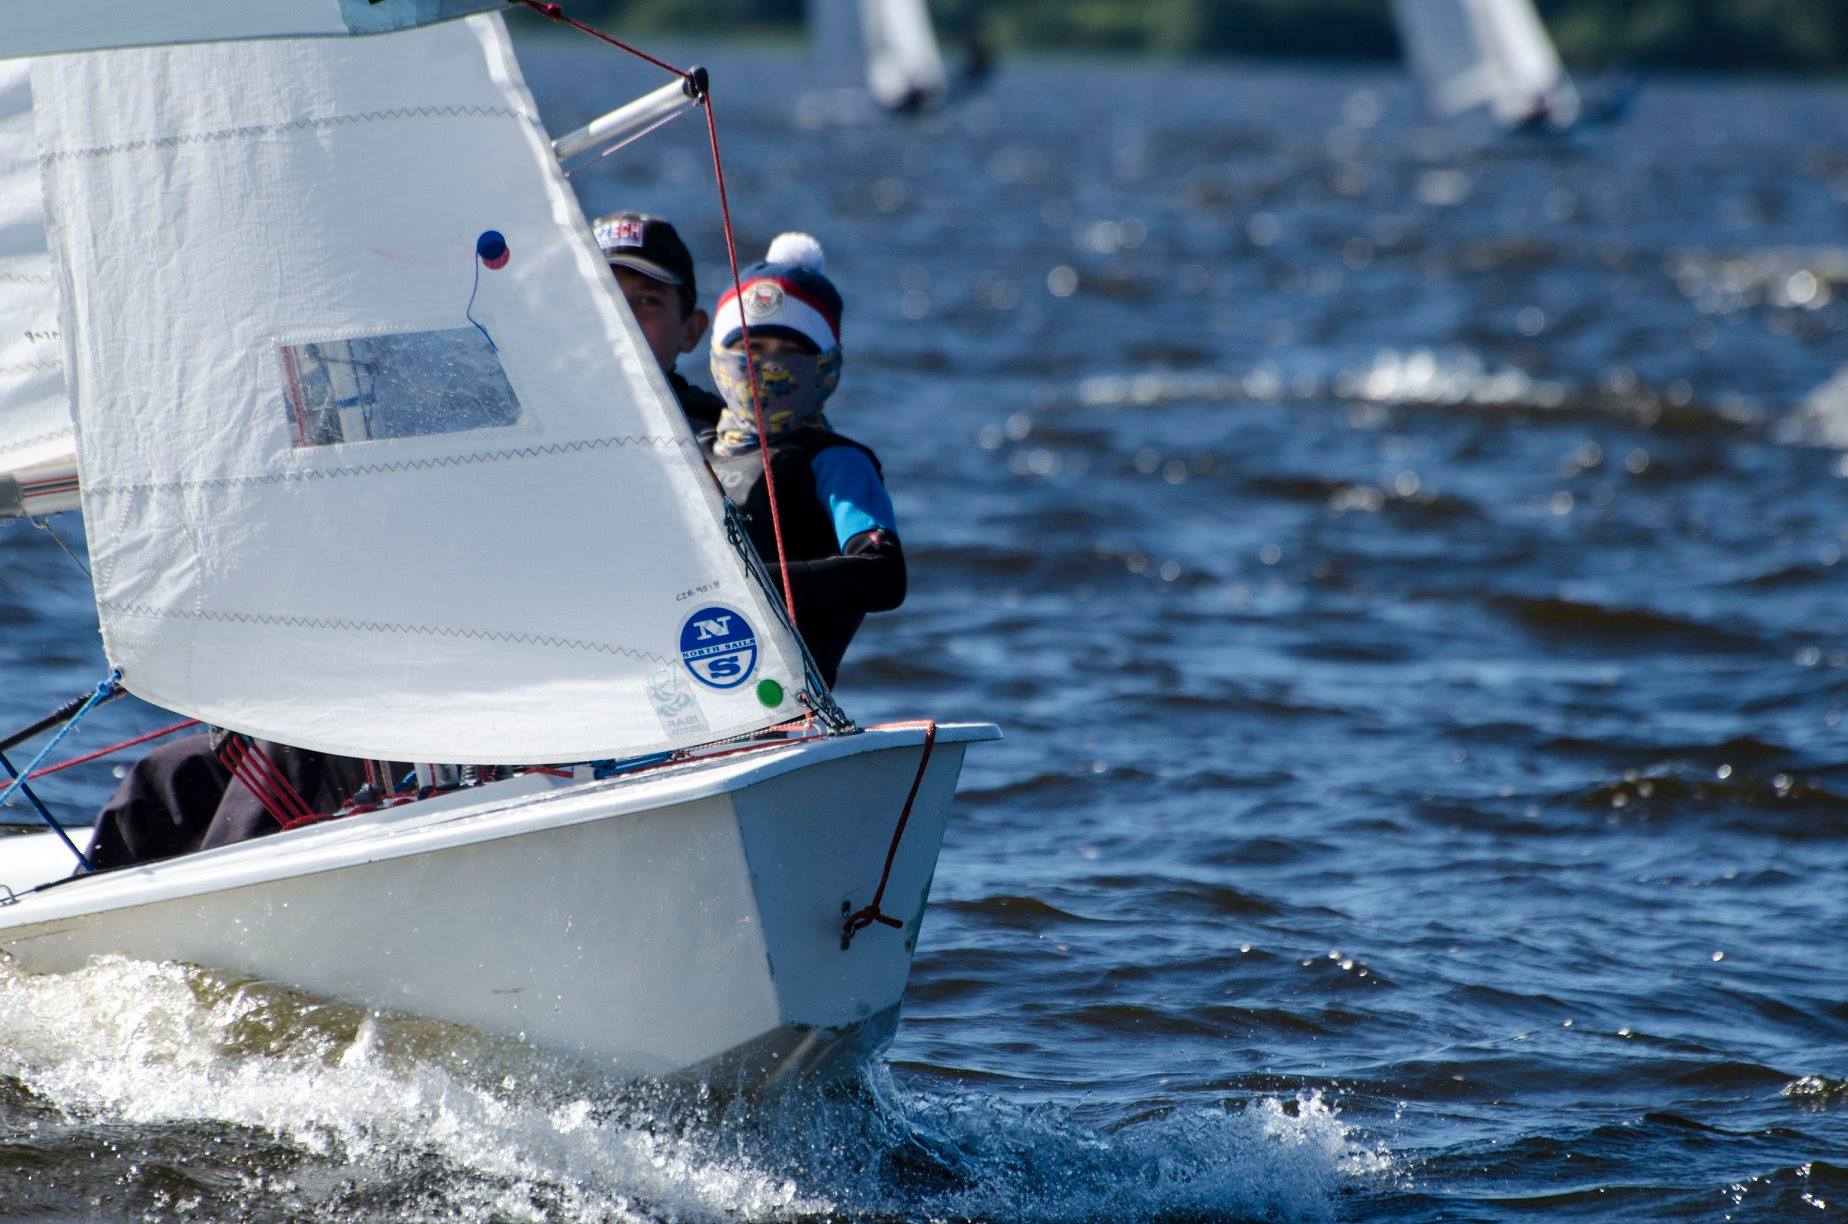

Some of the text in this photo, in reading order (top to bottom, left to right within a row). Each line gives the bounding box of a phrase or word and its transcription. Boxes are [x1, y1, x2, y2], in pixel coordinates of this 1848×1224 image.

[693, 615, 732, 641] N
[682, 638, 756, 659] NORTH SAILS
[708, 655, 741, 679] S
